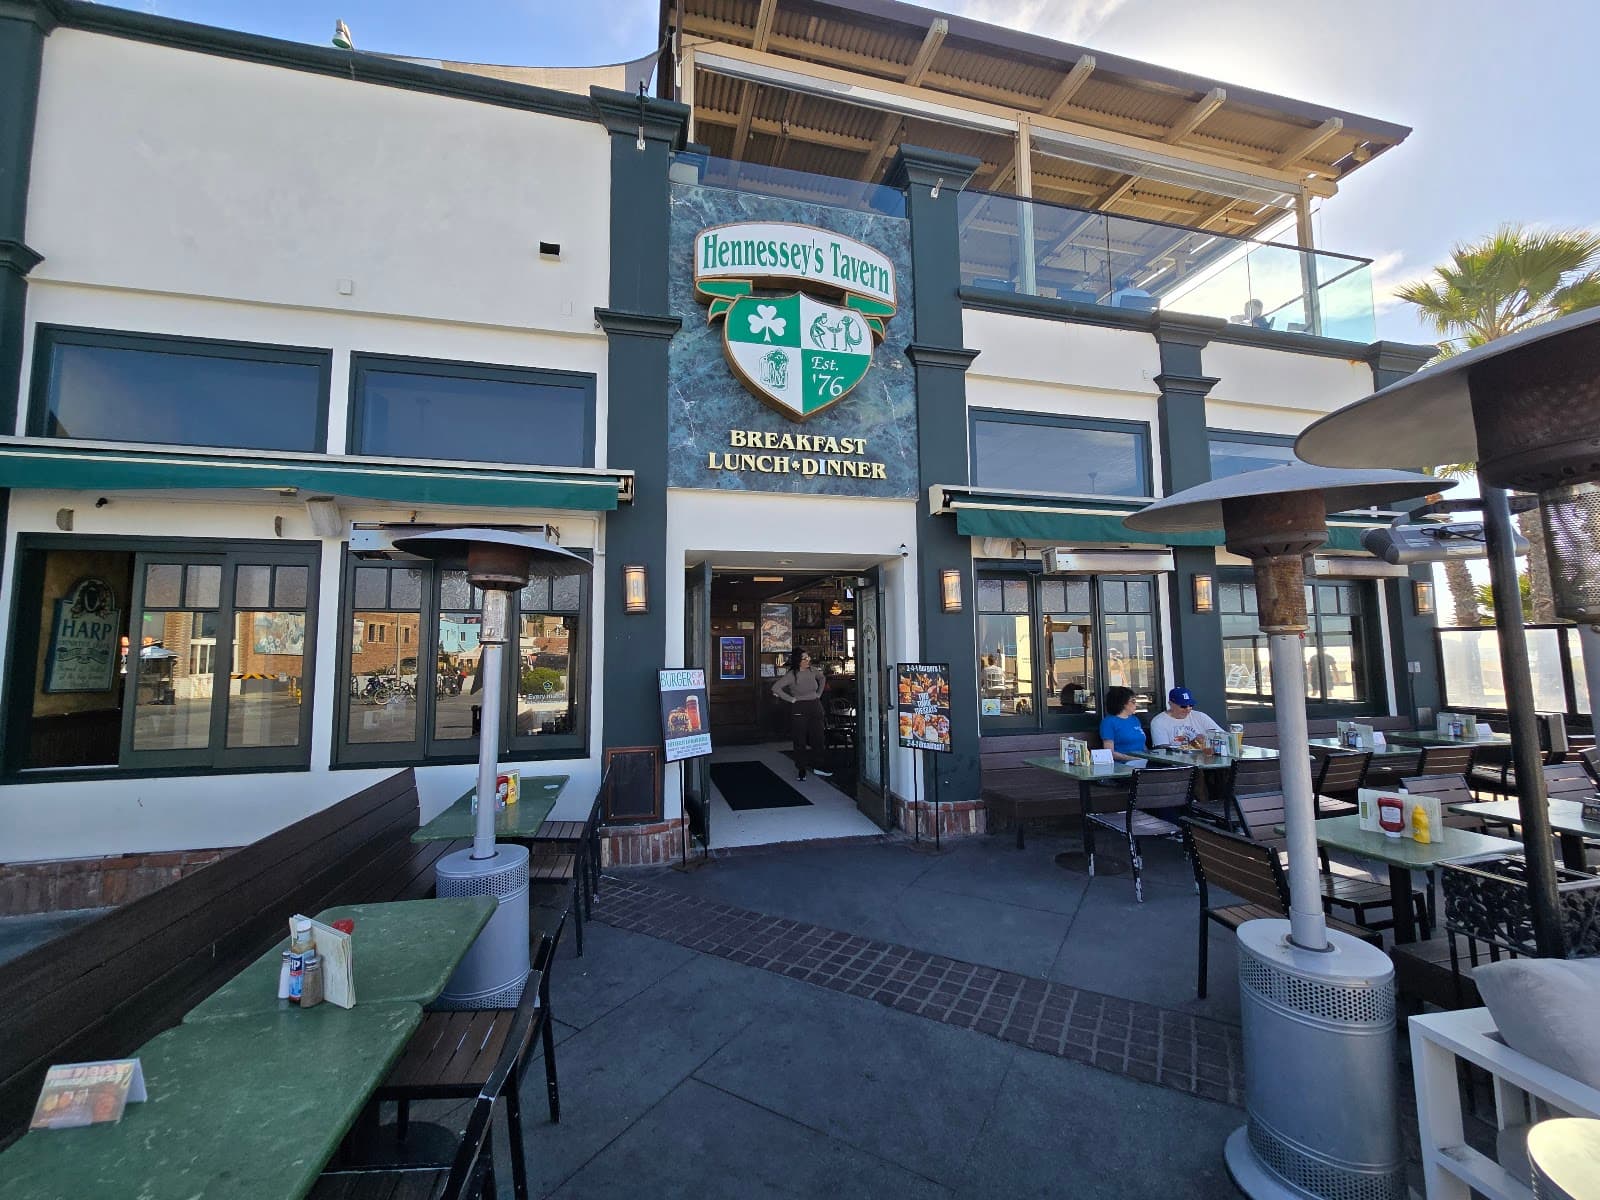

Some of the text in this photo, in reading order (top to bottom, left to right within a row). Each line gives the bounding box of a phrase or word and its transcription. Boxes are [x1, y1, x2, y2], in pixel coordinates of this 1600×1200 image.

[703, 234, 889, 294] Hennessey's Tavern
[811, 356, 839, 371] Est.
[812, 375, 843, 397] '76
[730, 430, 867, 454] BREAKFAST
[708, 452, 888, 480] LUNCH DINNER
[62, 619, 112, 640] HARP
